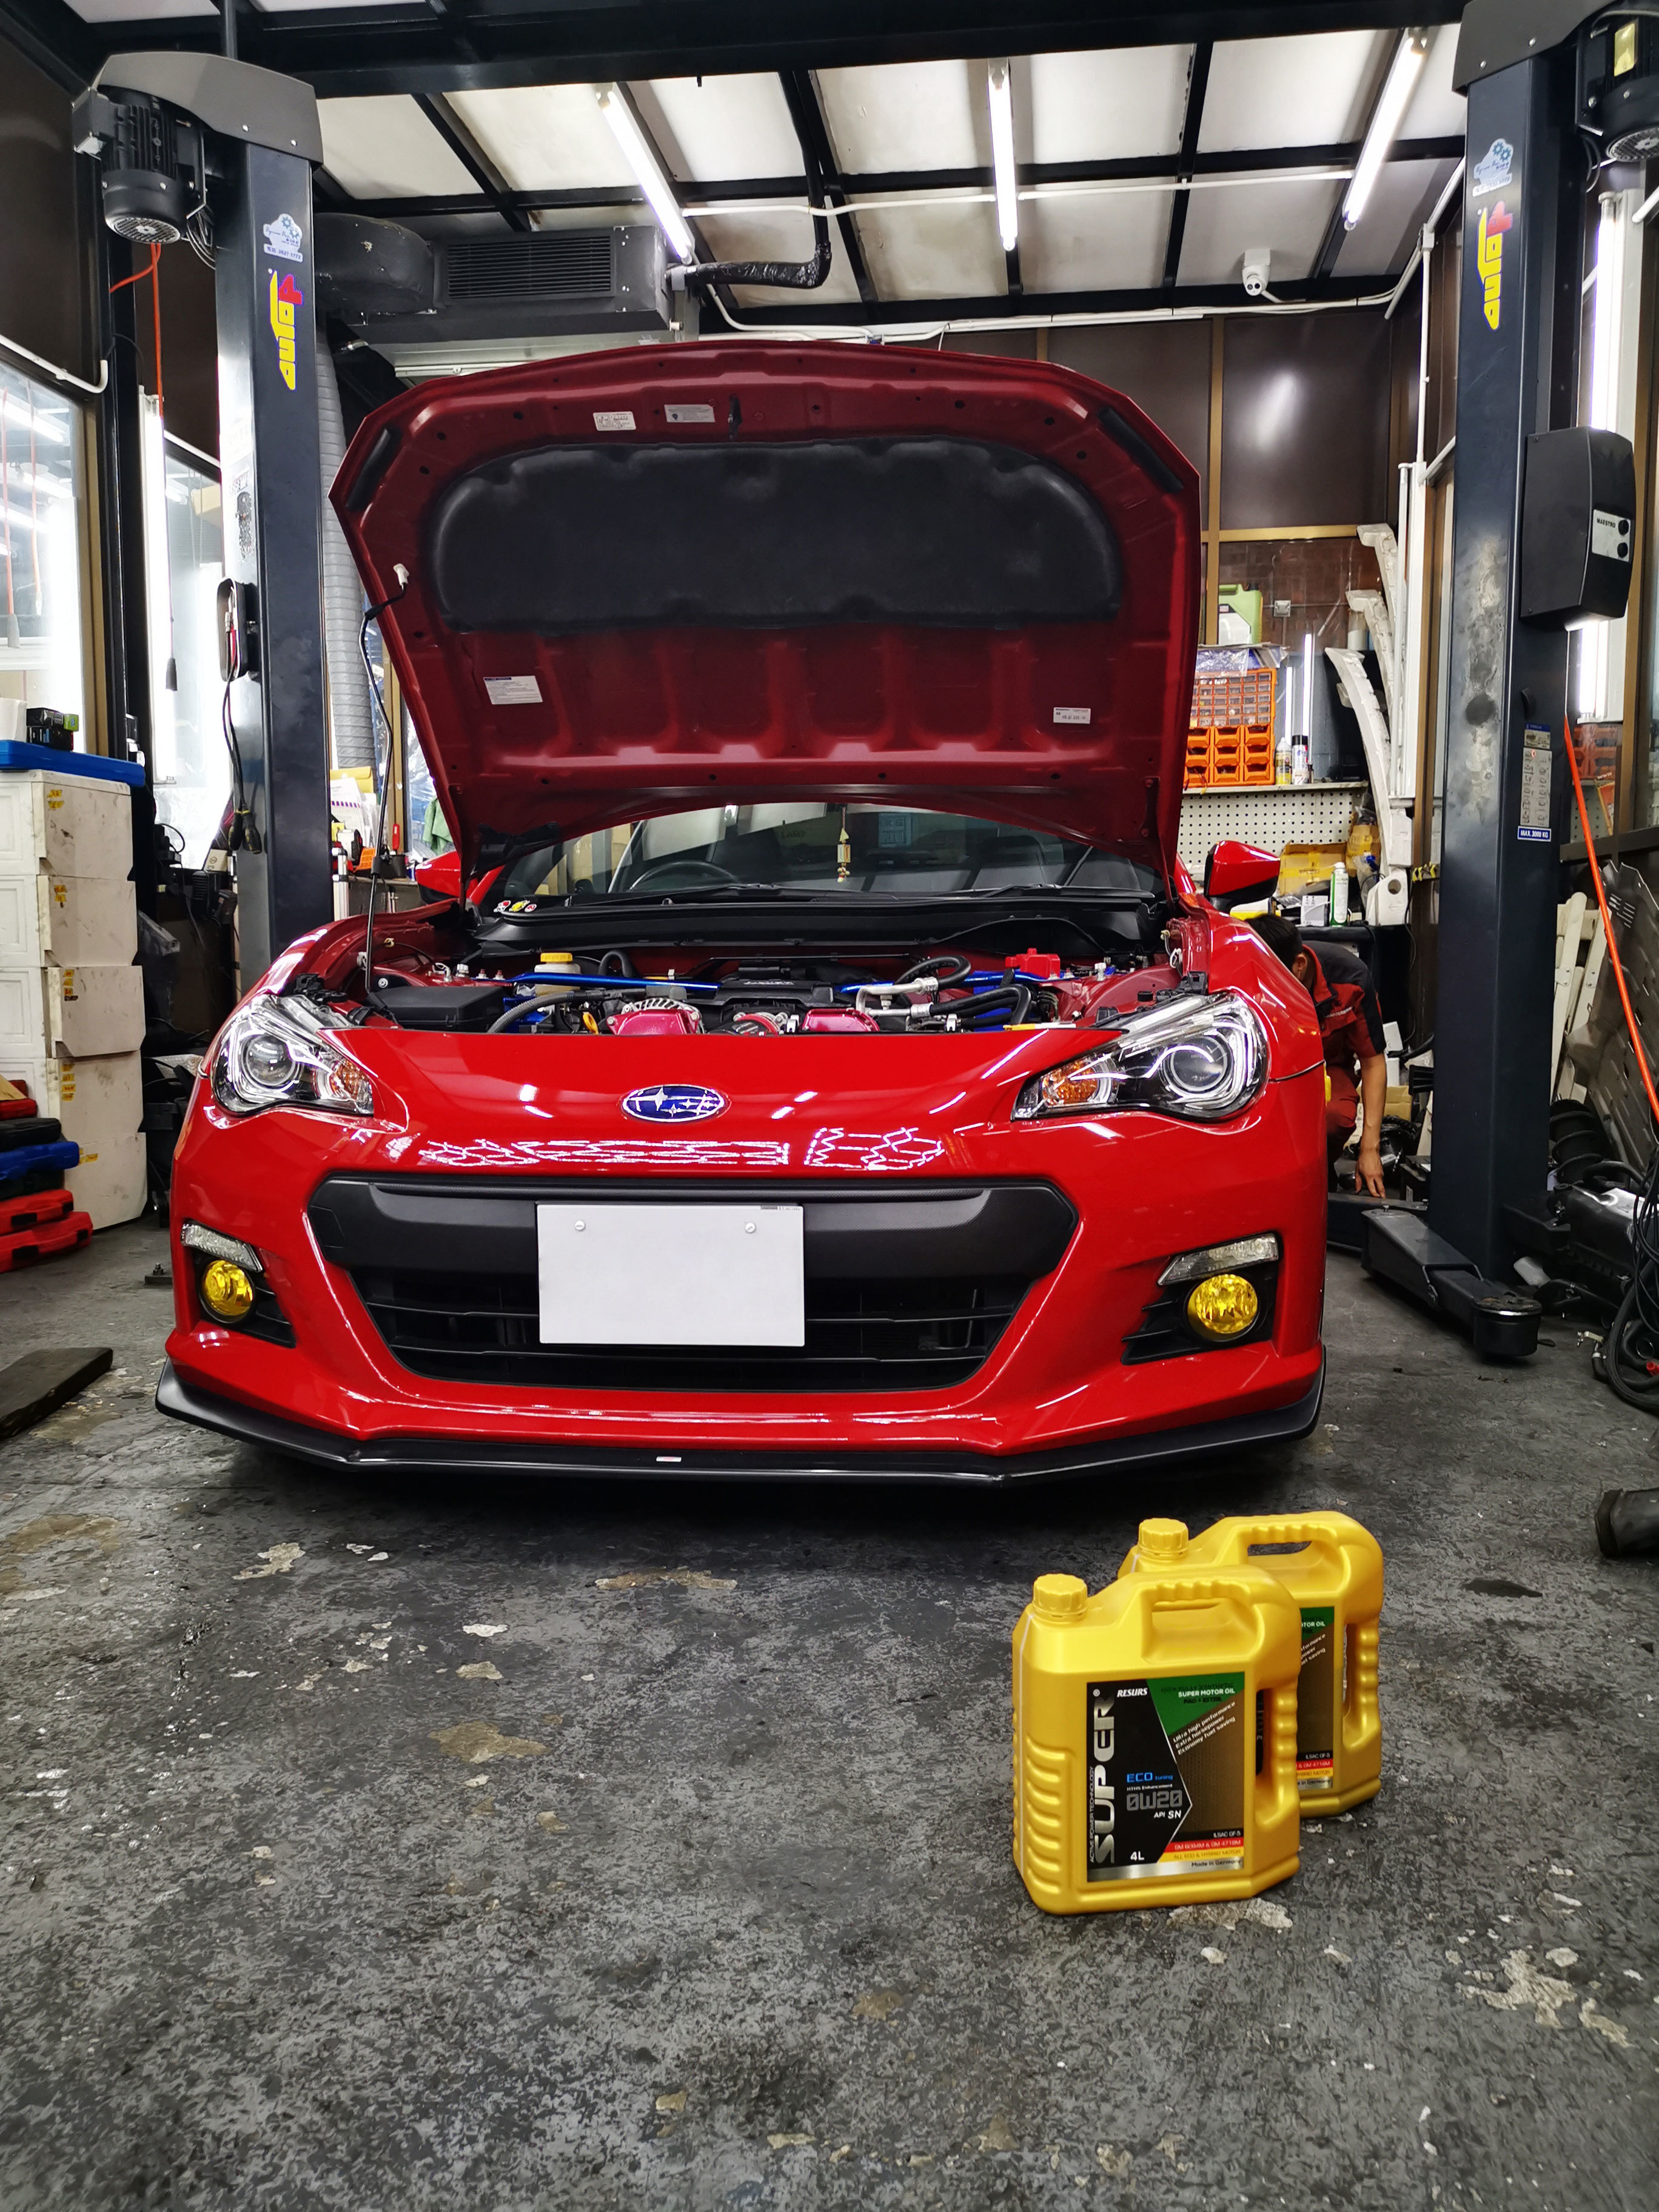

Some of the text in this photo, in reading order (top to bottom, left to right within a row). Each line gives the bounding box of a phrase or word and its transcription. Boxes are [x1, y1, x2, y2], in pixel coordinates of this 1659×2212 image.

[1597, 518, 1616, 528] MAESTRO
[1117, 1687, 1148, 1698] RESURS
[1173, 1701, 1236, 1743] Ultra high performance
[1175, 1715, 1224, 1749] Extra horsepower
[1178, 1717, 1236, 1755] Economy fuel saving
[1094, 1697, 1114, 1863] SUPER
[1127, 1772, 1153, 1783] ECO
[1127, 1789, 1182, 1811] 0W20
[1168, 1809, 1182, 1819] SN
[1130, 1851, 1145, 1861] 4L
